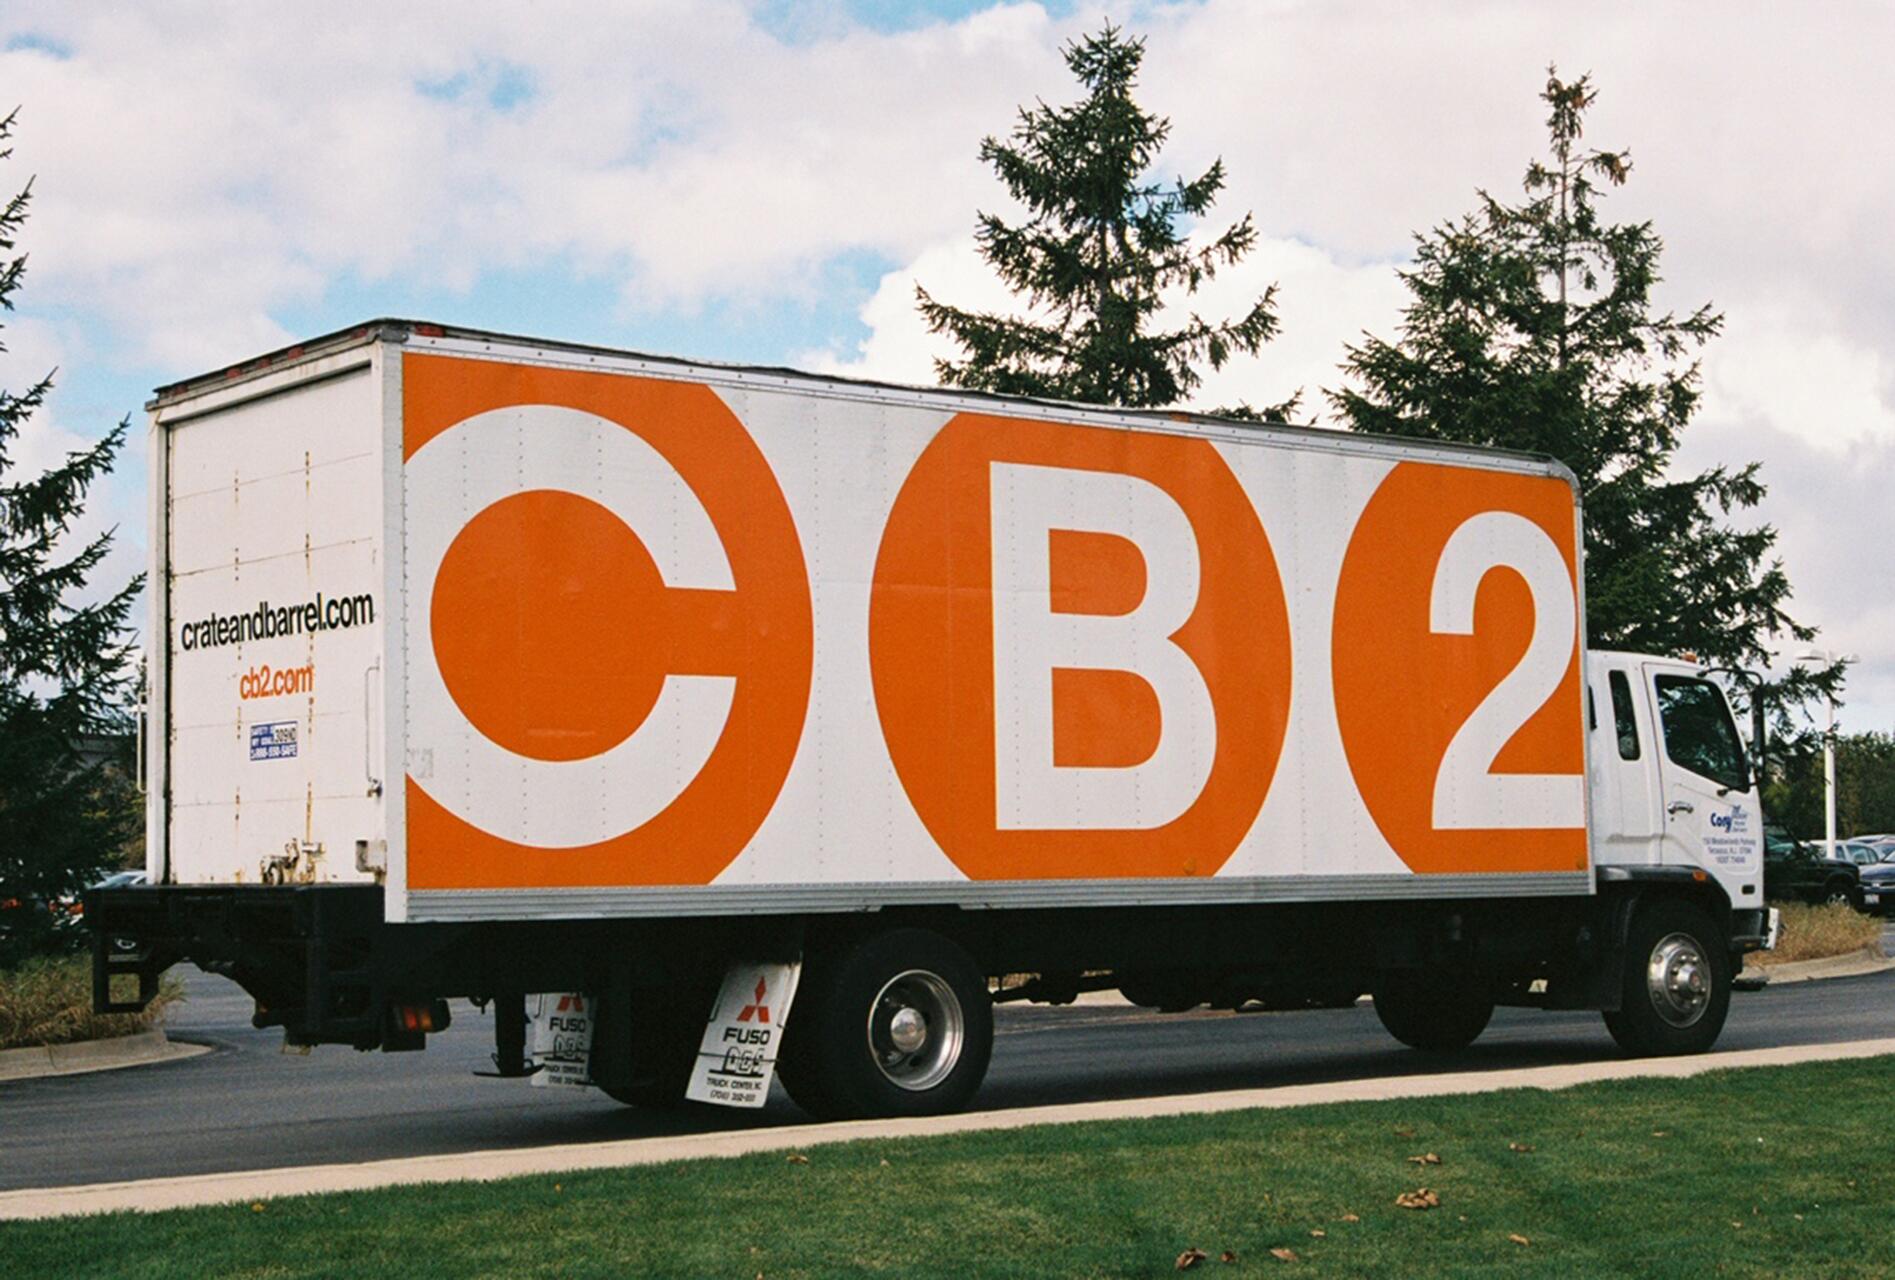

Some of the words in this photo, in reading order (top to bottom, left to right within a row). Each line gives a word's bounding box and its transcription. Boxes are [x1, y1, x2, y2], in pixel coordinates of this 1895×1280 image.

[181, 592, 374, 651] crateandbarrel.com
[239, 665, 313, 700] cb2.com
[1710, 812, 1732, 833] Cory
[549, 1017, 586, 1032] FUSO
[722, 1027, 771, 1045] FUSO
[706, 1077, 729, 1088] TRUCK
